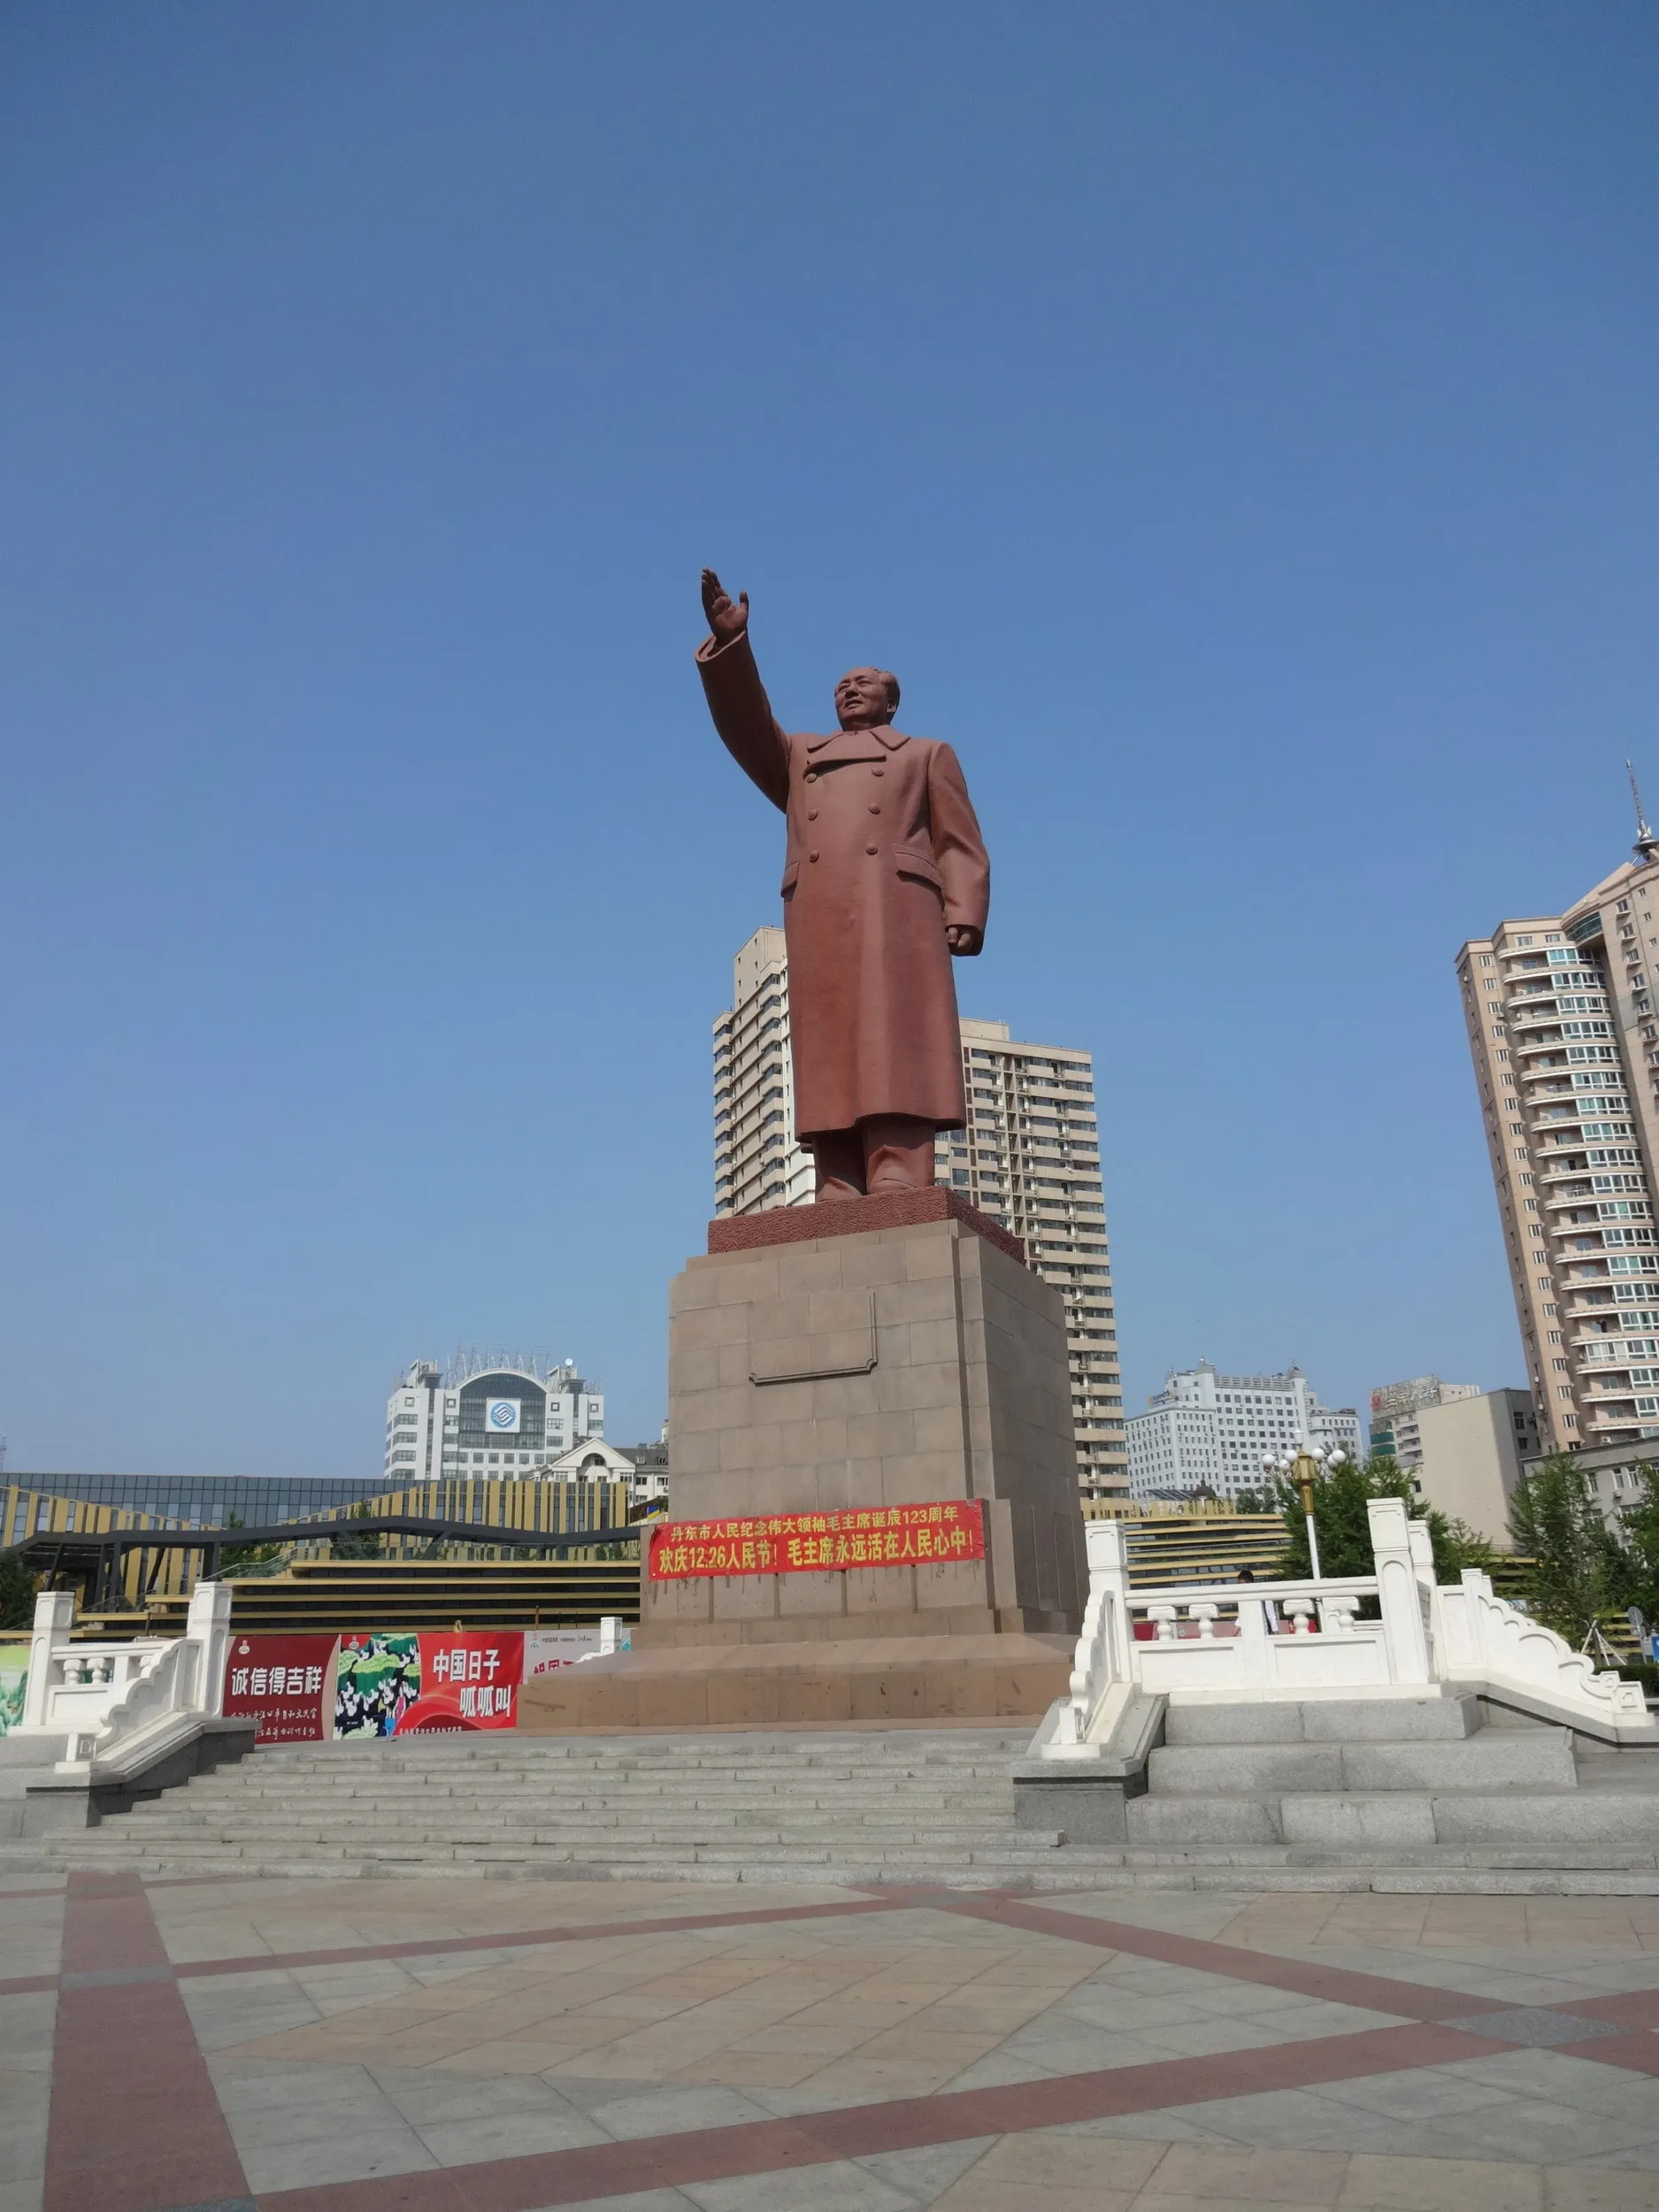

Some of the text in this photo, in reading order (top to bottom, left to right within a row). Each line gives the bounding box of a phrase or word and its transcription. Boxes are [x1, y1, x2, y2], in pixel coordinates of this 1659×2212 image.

[671, 1505, 958, 1542] 丹东市人民纪念伟大领袖毛主席诞辰123周年
[231, 1666, 322, 1696] 诚信得吉祥
[433, 1648, 501, 1683] 中国日子
[459, 1684, 511, 1717] 呱呱叫
